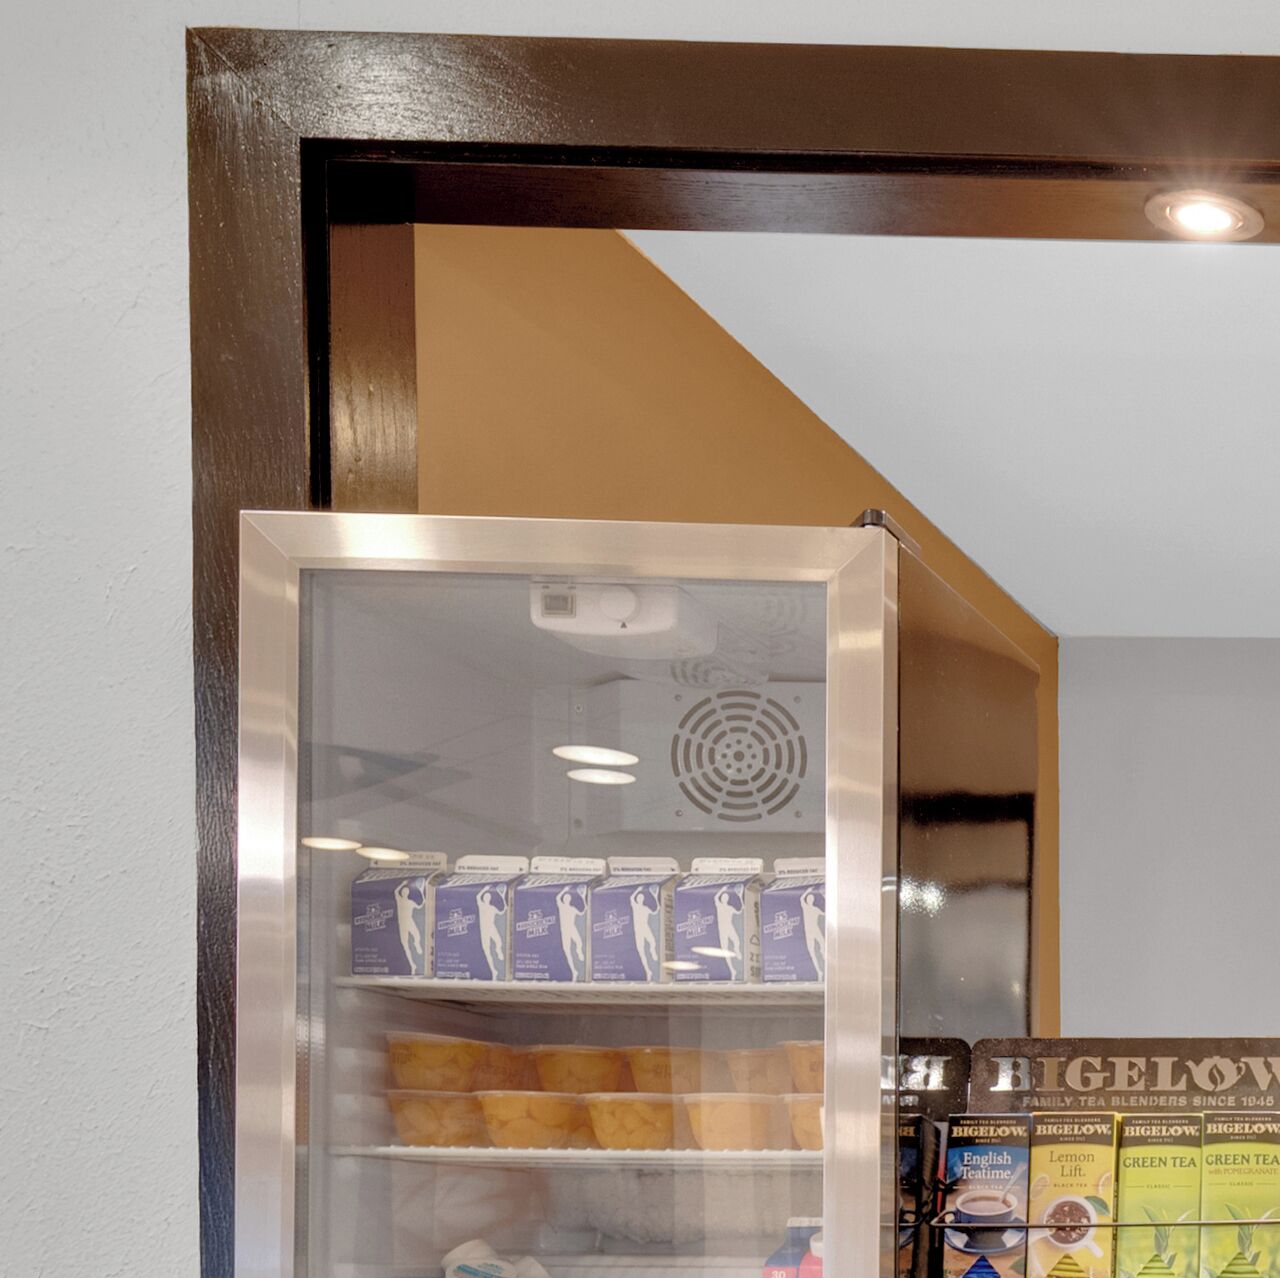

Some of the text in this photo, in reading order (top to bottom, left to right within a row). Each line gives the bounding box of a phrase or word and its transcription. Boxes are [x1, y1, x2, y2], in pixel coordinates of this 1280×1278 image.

[1023, 1096, 1275, 1107] FAMILY TEA BLENDERS SINCE 1945
[952, 1126, 1027, 1138] BIGELOW
[1035, 1124, 1111, 1136] BIGELOW
[1123, 1125, 1199, 1137] BIGELOW
[963, 1152, 1012, 1168] English
[1049, 1151, 1095, 1163] Lemon
[1123, 1157, 1197, 1168] GREEN TEA
[1205, 1154, 1280, 1166] GREEN TEA
[960, 1167, 1014, 1179] Teatime.
